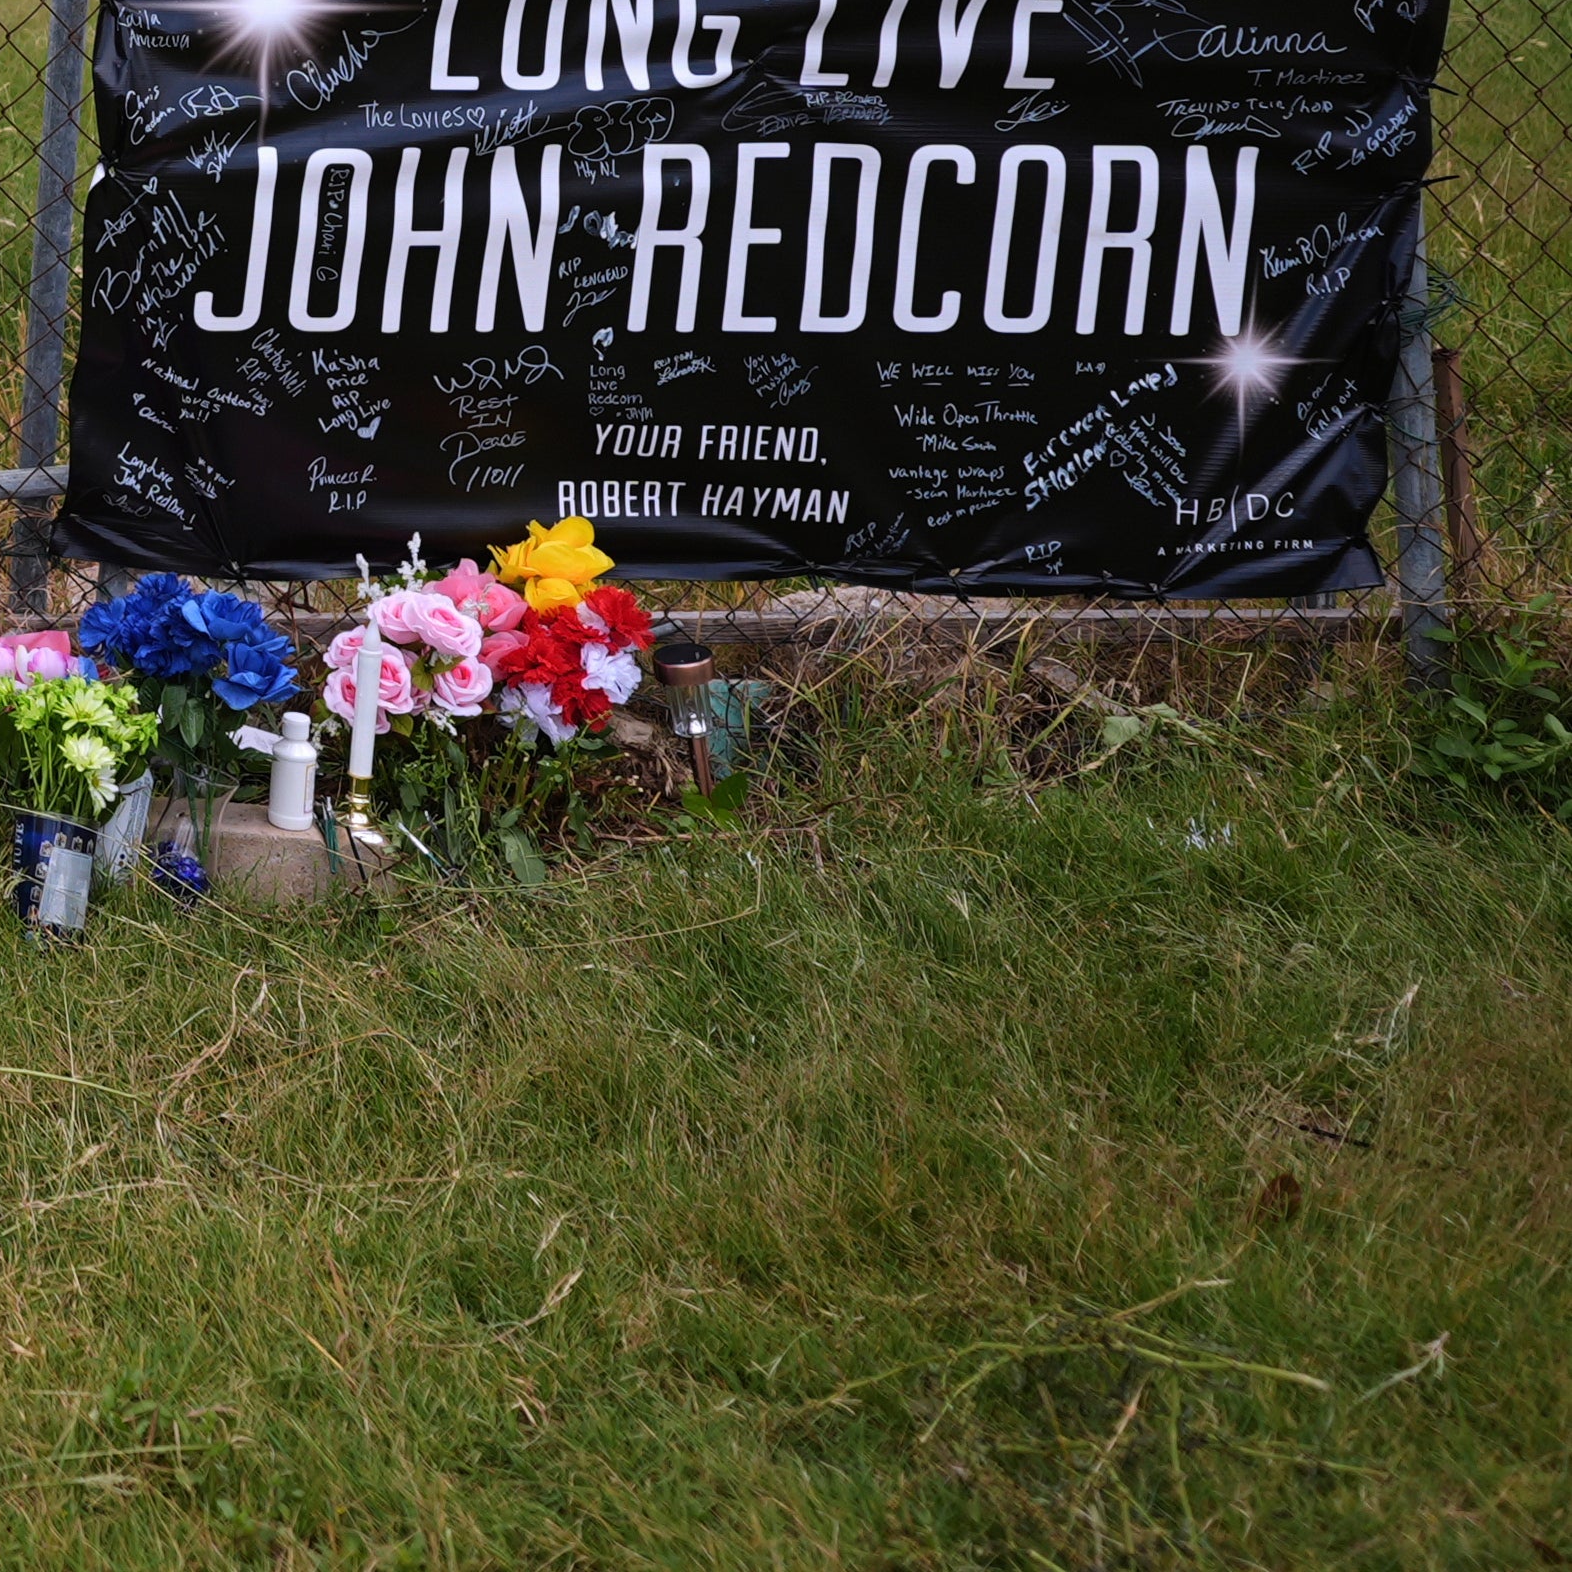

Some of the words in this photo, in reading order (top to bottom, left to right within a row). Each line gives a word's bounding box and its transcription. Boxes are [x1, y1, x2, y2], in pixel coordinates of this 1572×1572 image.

[1276, 68, 1367, 88] Martinez
[358, 99, 395, 129] The
[193, 143, 563, 334] JOHN
[626, 141, 1260, 336] REDCORN
[589, 363, 626, 379] Long
[877, 360, 902, 382] WE
[912, 362, 954, 379] WILL
[448, 393, 520, 419] Rest
[893, 403, 937, 428] Wide
[942, 402, 980, 429] Open
[973, 400, 1039, 426] Throttle
[596, 423, 682, 458] YOUR
[699, 424, 827, 466] FRIEND,
[558, 480, 686, 518] ROBERT
[702, 483, 850, 524] HAYMAN
[1157, 545, 1166, 556] A
[1175, 540, 1264, 556] MARKETING
[1274, 538, 1314, 550] FIRM
